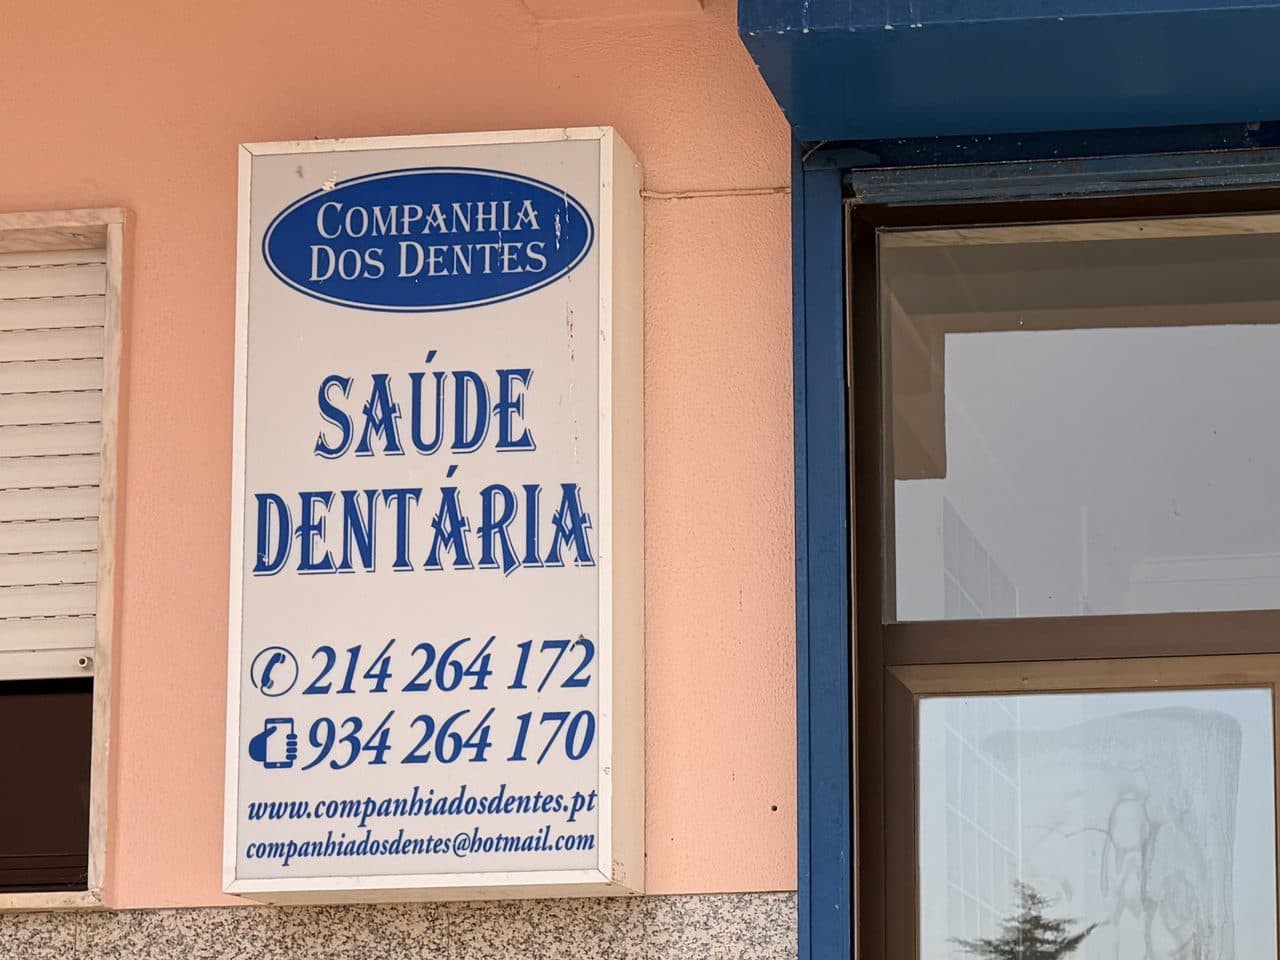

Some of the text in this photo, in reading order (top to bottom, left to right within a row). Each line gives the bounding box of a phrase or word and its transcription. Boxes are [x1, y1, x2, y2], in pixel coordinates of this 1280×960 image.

[316, 199, 541, 239] COMPANHIA
[309, 240, 548, 282] DOS DENTES
[313, 349, 537, 460] SAÚDE
[252, 465, 596, 578] DENTÁRIA
[302, 635, 595, 696] 214 264 172
[301, 707, 596, 771] 934 264 170
[247, 784, 598, 827] www.companhiadosdentes.pt
[246, 825, 595, 866] companhiadosdentes@hotmail.com
